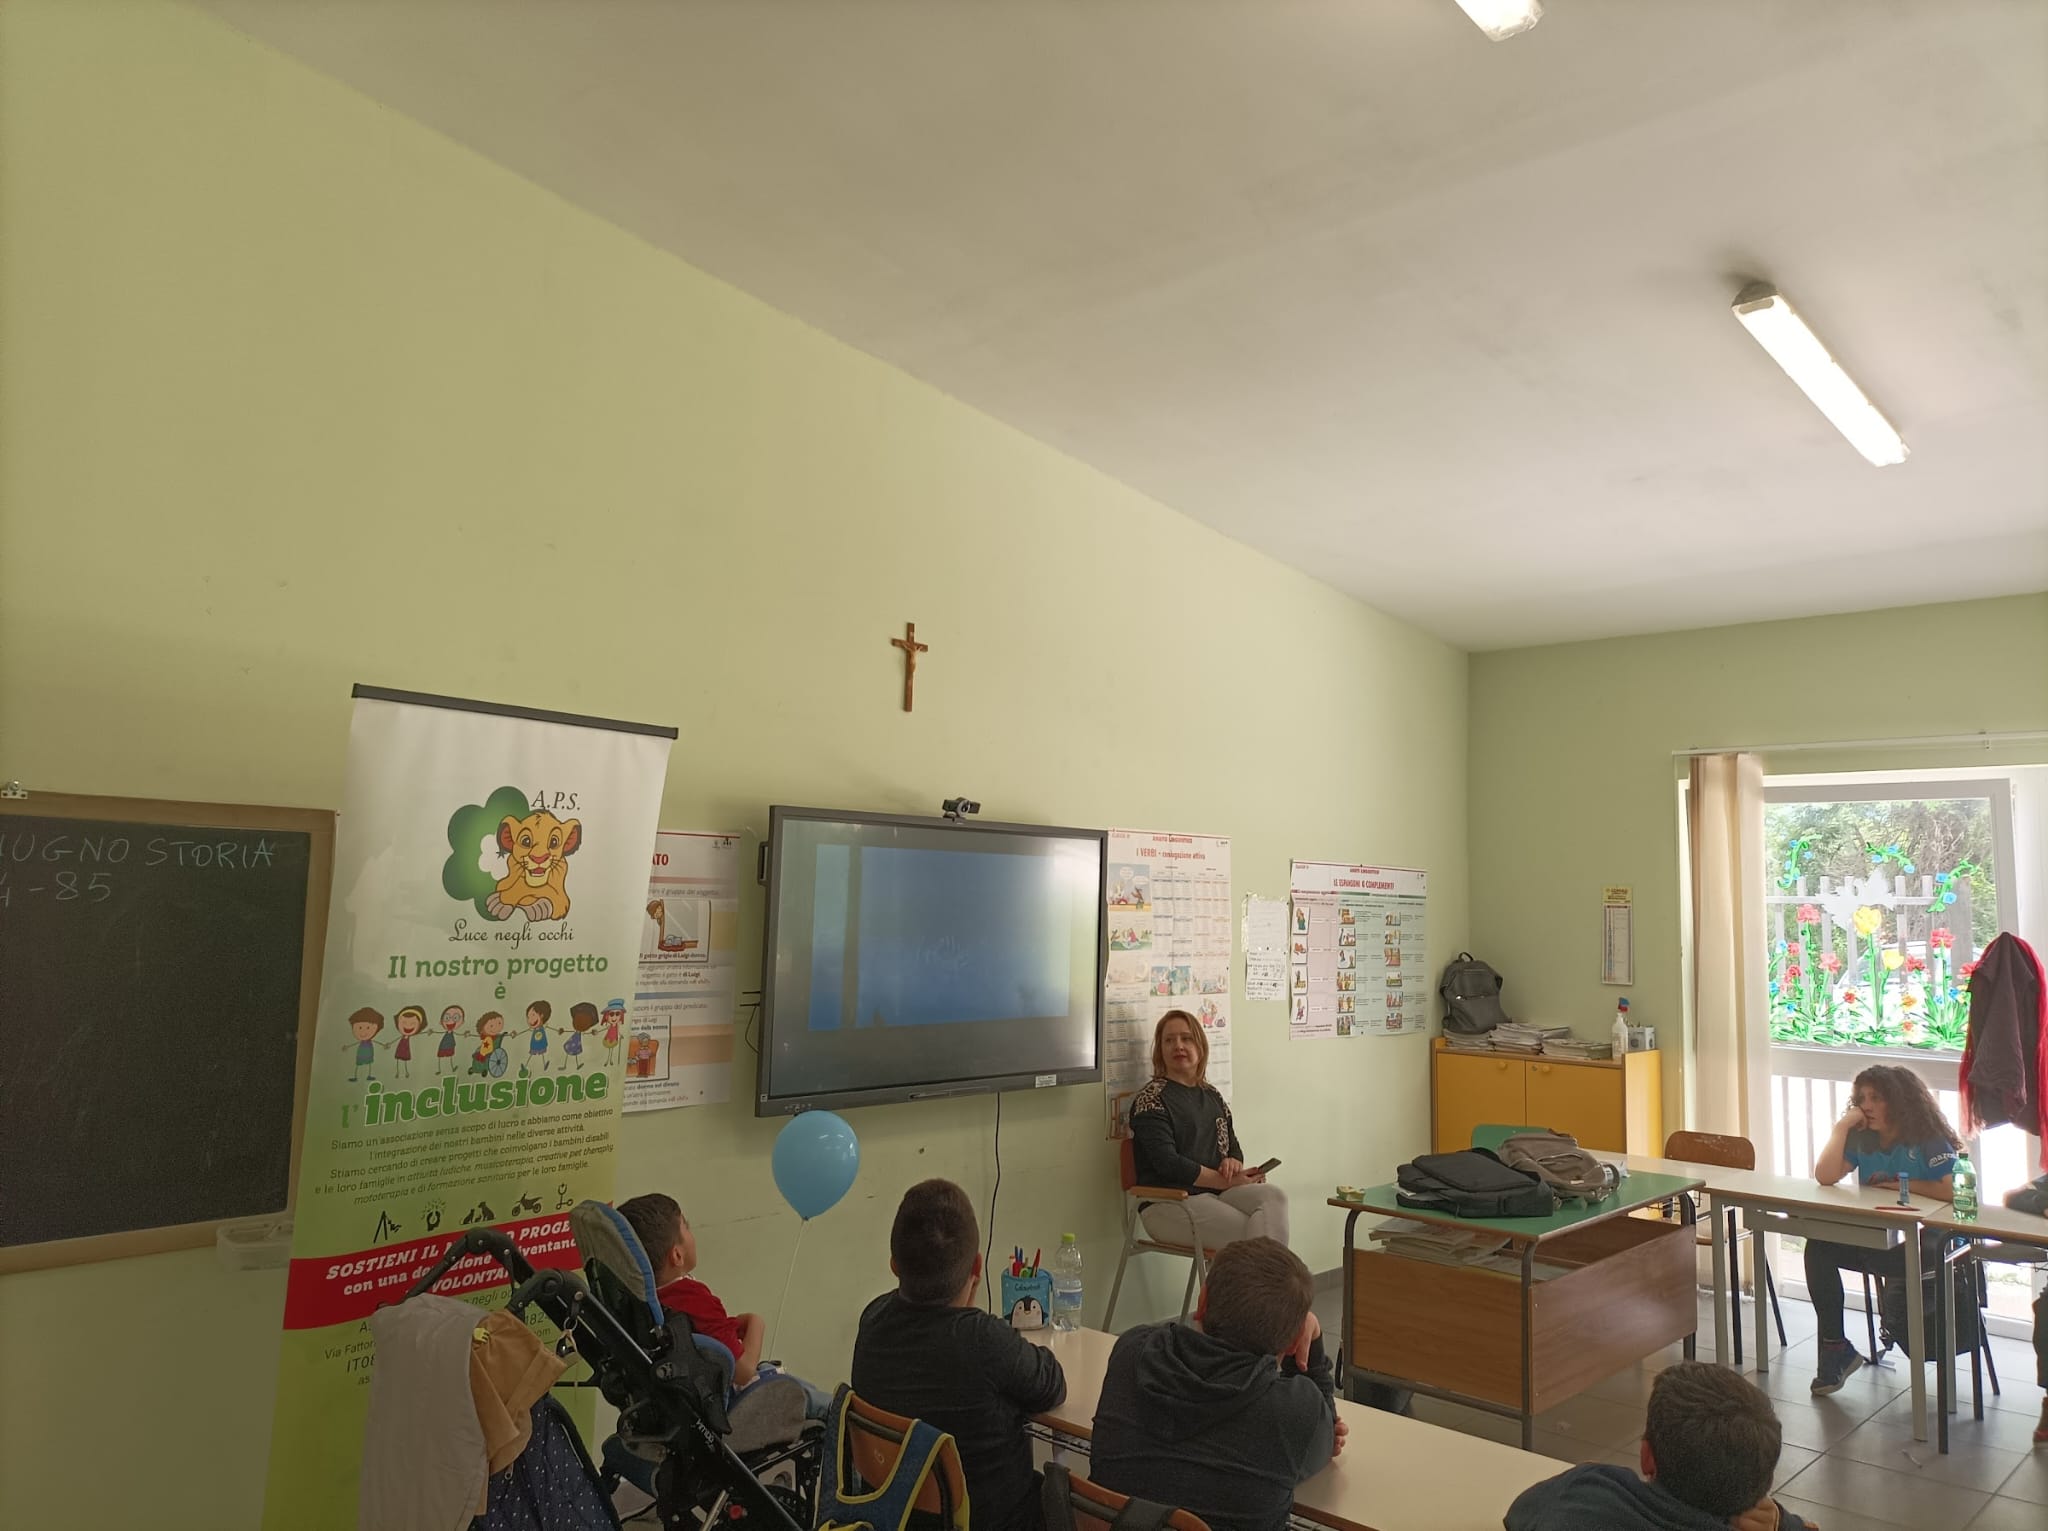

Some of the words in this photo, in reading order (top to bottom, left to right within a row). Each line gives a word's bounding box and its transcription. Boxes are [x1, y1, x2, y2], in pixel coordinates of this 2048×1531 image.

[531, 790, 582, 811] A.P.S.
[145, 838, 277, 869] STORIA
[448, 918, 489, 942] Luce
[494, 922, 533, 950] negli
[538, 922, 575, 942] occhi
[388, 955, 407, 978] Il
[415, 955, 499, 978] nostro
[507, 953, 609, 980] progetto
[331, 1139, 364, 1151] Siamo
[435, 1125, 460, 1137] senza
[461, 1123, 487, 1135] scopo
[488, 1121, 496, 1130] di
[498, 1117, 519, 1129] lucro
[520, 1119, 526, 1127] e
[527, 1114, 561, 1126] abbiamo
[561, 1111, 583, 1121] come
[583, 1108, 614, 1119] obiettivo
[428, 1141, 442, 1151] dei
[444, 1138, 469, 1149] nostri
[470, 1133, 505, 1146] bambini
[506, 1129, 526, 1140] nelle
[527, 1126, 556, 1138] diverse
[330, 1167, 366, 1180] Stiamo
[367, 1160, 409, 1175] cercando
[410, 1158, 419, 1168] di
[420, 1154, 447, 1166] creare
[448, 1150, 482, 1165] progetti
[483, 1146, 499, 1157] che
[500, 1140, 549, 1154] coinvolgano
[553, 1135, 585, 1147] bambini
[324, 1184, 334, 1194] le
[337, 1182, 358, 1194] loro
[359, 1174, 396, 1190] famiglie
[397, 1174, 406, 1183] in
[353, 1188, 409, 1205] mototerapia
[418, 1184, 426, 1193] di
[517, 1169, 531, 1181] per
[532, 1166, 540, 1176] le
[541, 1163, 557, 1175] loro
[326, 1248, 418, 1280] SOSTIENI
[420, 1244, 439, 1260] IL
[519, 1219, 570, 1241] PROGE
[343, 1279, 373, 1296] con
[378, 1271, 408, 1288] una
[471, 1290, 498, 1307] negli
[325, 1348, 342, 1360] Via
